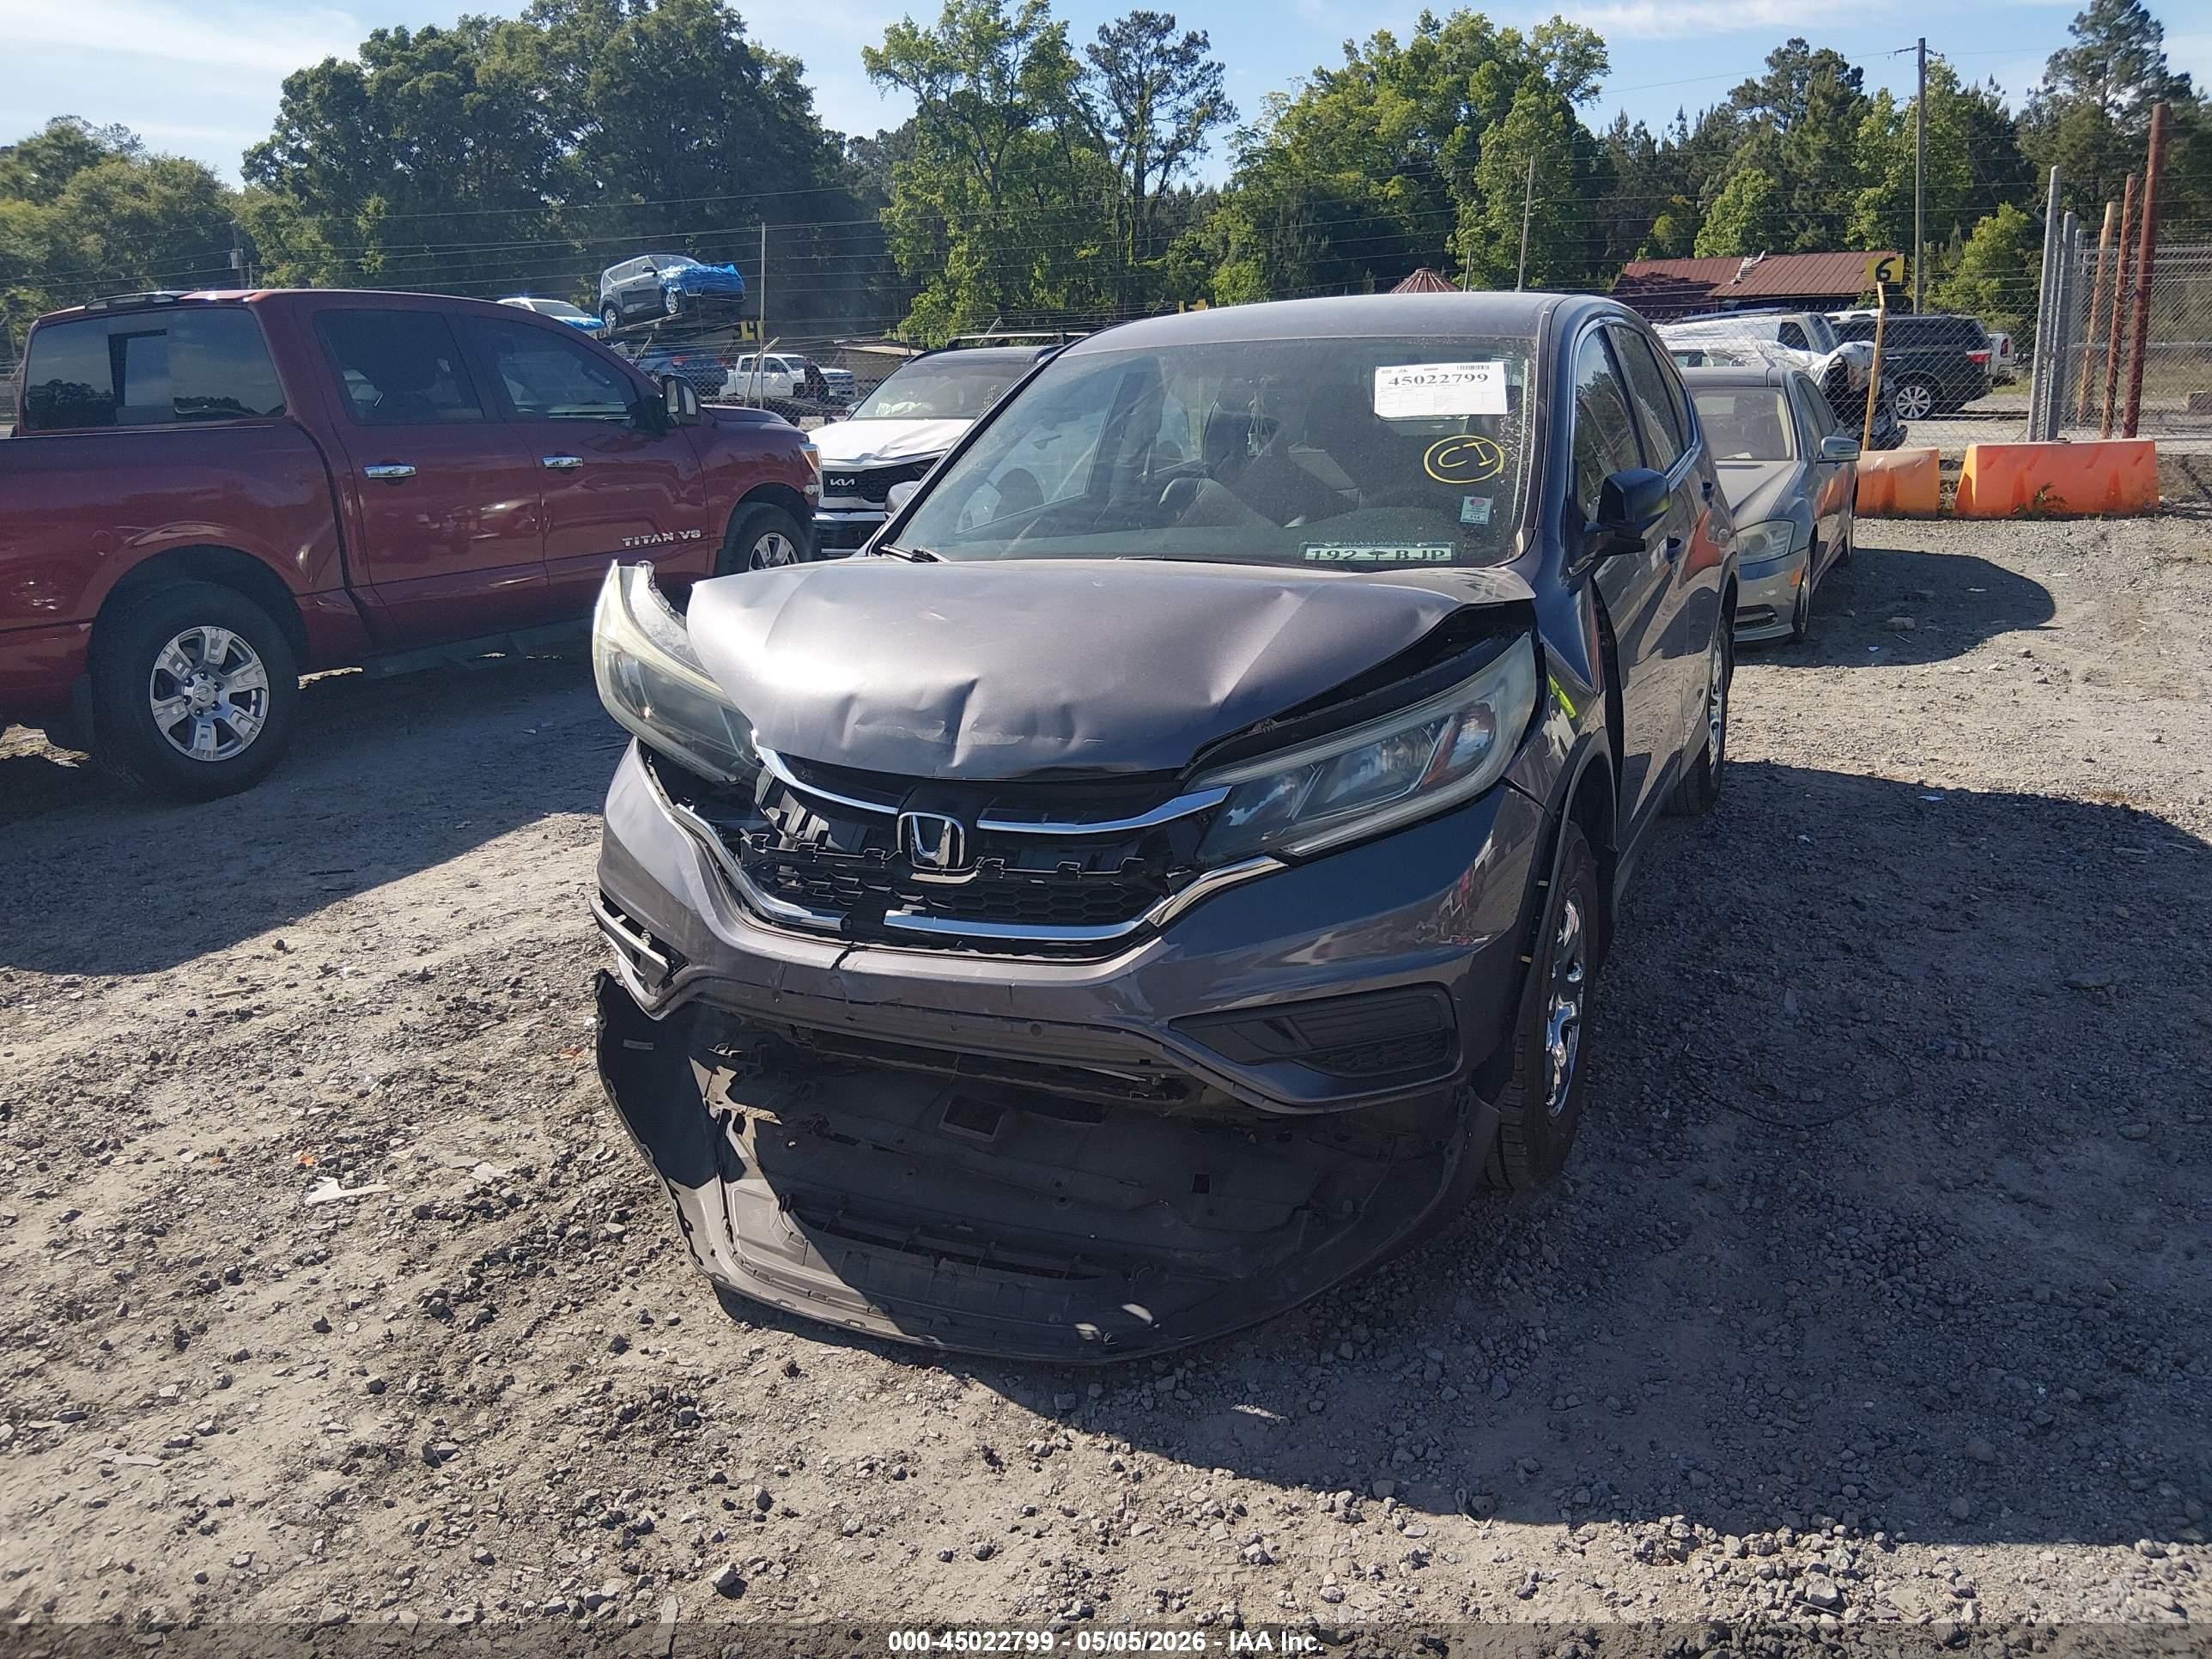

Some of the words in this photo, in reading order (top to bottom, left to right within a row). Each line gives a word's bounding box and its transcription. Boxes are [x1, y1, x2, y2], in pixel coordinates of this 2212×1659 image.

[1875, 257, 1896, 282] 6
[1388, 373, 1489, 386] 45022799
[622, 532, 674, 547] TITAN
[1311, 550, 1358, 560] 192
[1395, 550, 1446, 560] BJP
